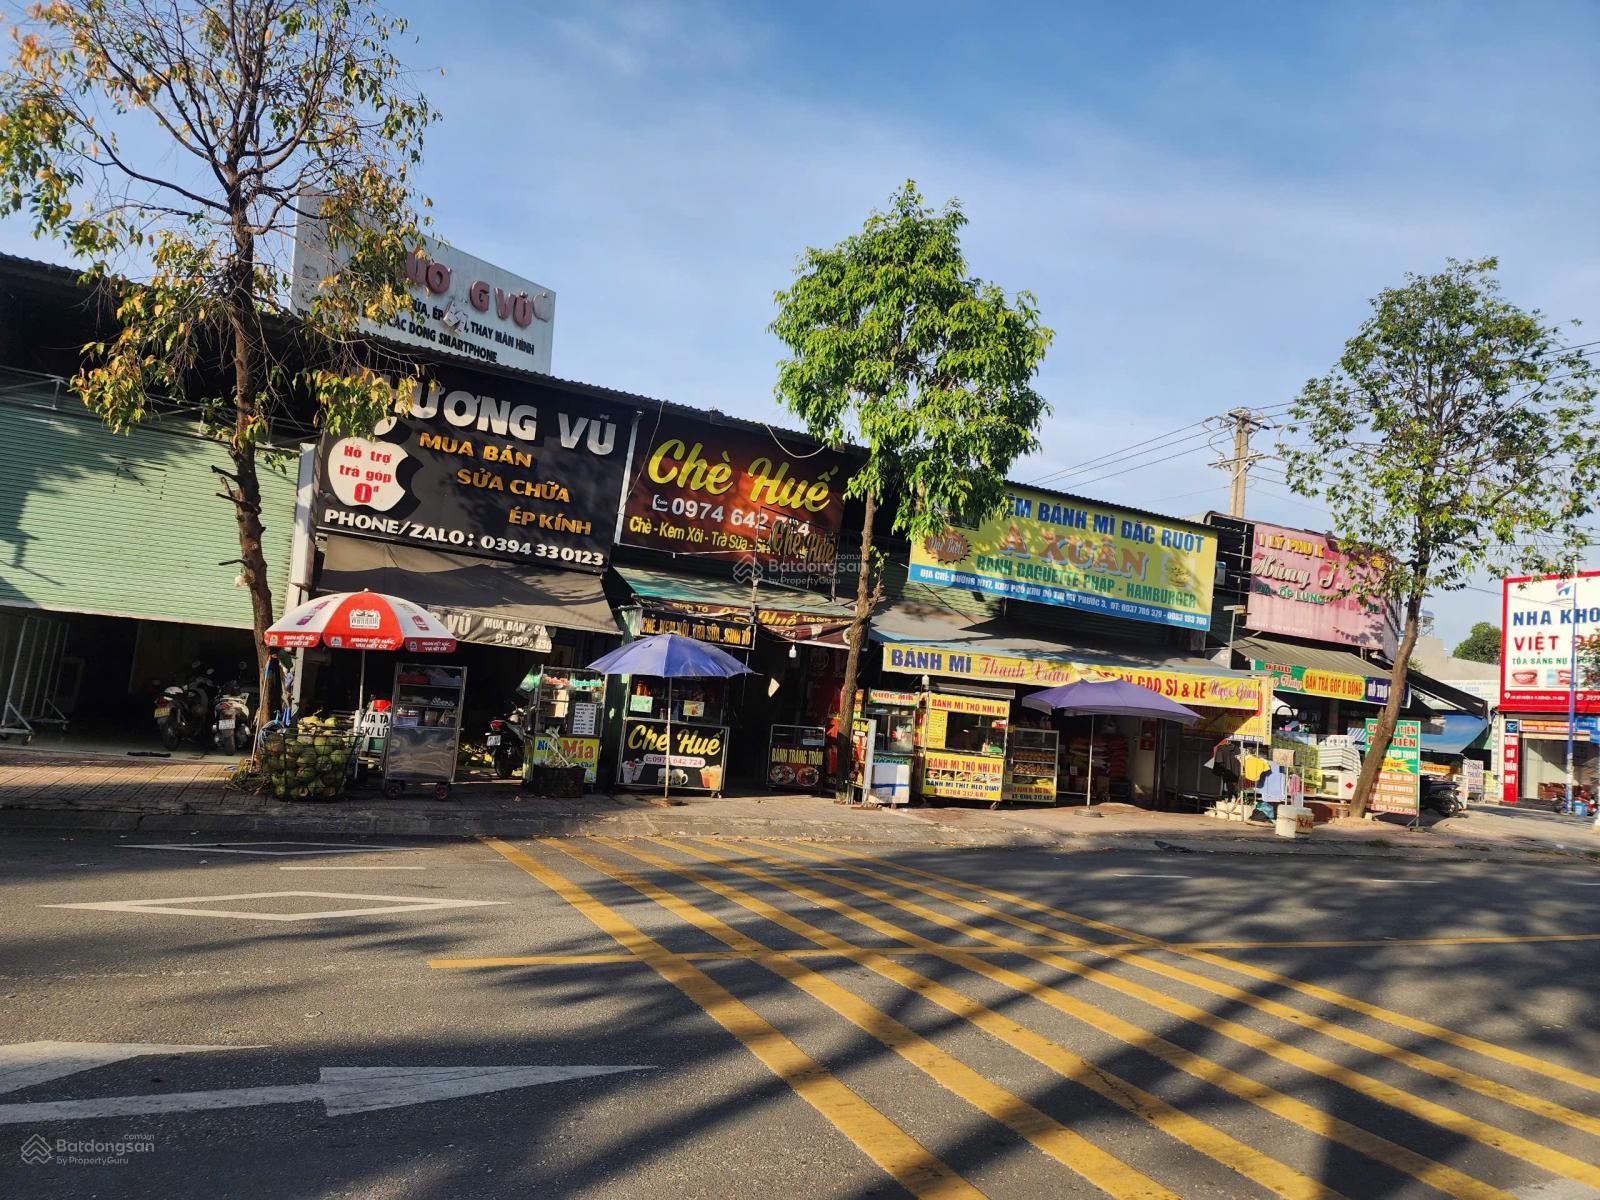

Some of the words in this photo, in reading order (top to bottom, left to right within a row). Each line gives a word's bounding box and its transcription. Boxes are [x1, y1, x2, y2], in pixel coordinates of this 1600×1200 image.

[470, 320, 494, 340] THAY
[439, 332, 497, 363] SMARTPHONE
[557, 411, 616, 456] VŨ
[344, 443, 362, 459] Hỗ
[370, 450, 392, 466] trợ
[419, 431, 474, 457] MUA
[483, 444, 532, 468] BÁN
[339, 464, 360, 478] trả
[366, 469, 392, 484] góp
[457, 467, 503, 492] SỬA
[510, 479, 570, 503] CHỮA
[648, 438, 734, 495] Chè
[747, 456, 839, 513] Huế
[508, 505, 536, 525] ÉP
[539, 510, 592, 535] KÍNH
[671, 497, 724, 523] 0974
[731, 508, 769, 531] 642
[1038, 501, 1088, 530] BÁNH
[1093, 510, 1116, 536] MÌ
[1121, 519, 1156, 546] ĐẶC
[1161, 529, 1204, 555] RUỘT
[629, 515, 652, 535] Chè
[659, 521, 685, 541] Kem
[686, 525, 704, 543] Xôi
[711, 529, 728, 547] Trà
[729, 532, 748, 551] Sữa
[480, 534, 531, 556] 0394
[535, 543, 559, 560] 33
[564, 546, 604, 566] 0123
[1039, 530, 1149, 581] XUÂN
[1017, 562, 1079, 588] BAGUETTE
[1083, 573, 1115, 593] PHÁP
[1126, 582, 1197, 609] HAMBURGER
[758, 610, 800, 628] Huế
[1121, 603, 1137, 614] 0937
[1513, 610, 1552, 626] NHA
[447, 612, 473, 636] VŨ
[483, 617, 505, 631] MUA
[506, 620, 526, 633] BÁN
[495, 633, 510, 644] ĐT:
[1514, 631, 1559, 655] VIỆT
[891, 648, 942, 671] BÁNH
[949, 653, 971, 674] MÌ
[979, 656, 1026, 679] Thanh
[677, 728, 724, 756] Huế
